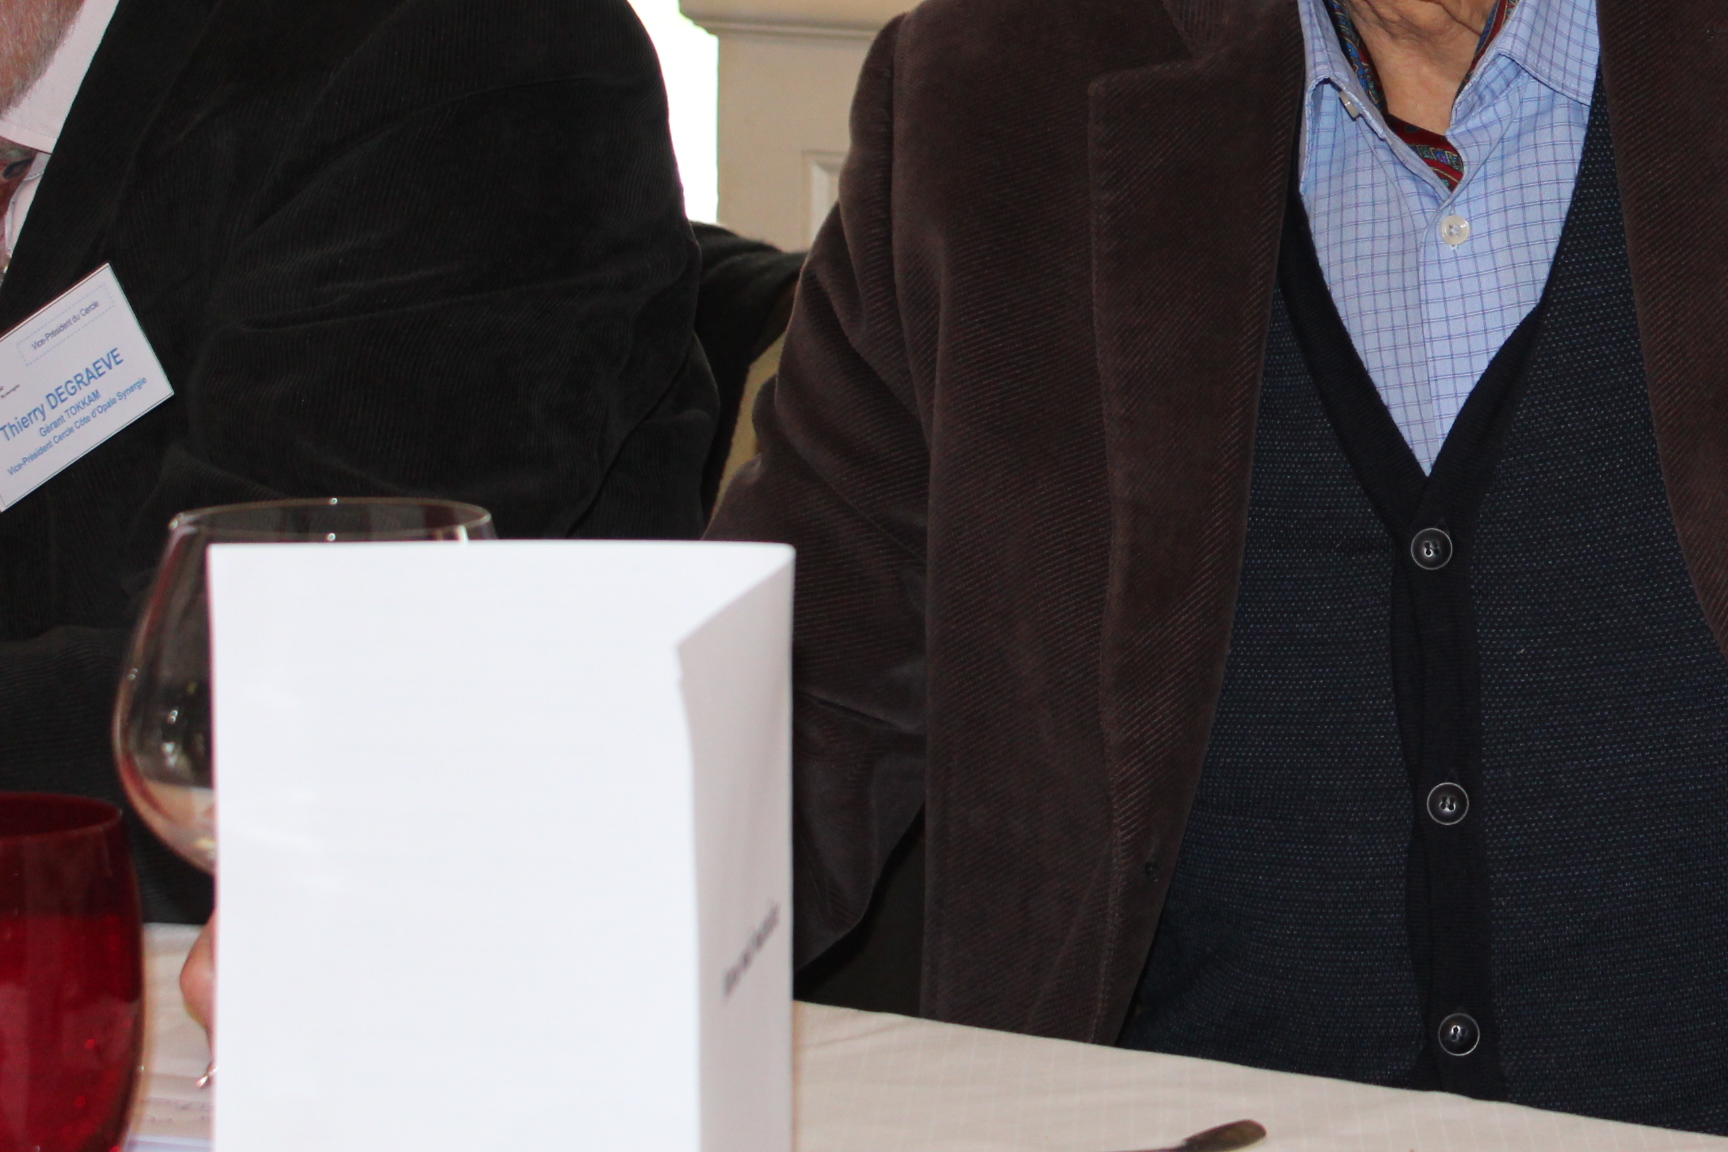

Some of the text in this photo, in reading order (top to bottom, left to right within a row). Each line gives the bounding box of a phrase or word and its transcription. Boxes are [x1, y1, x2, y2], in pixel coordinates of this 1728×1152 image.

[31, 300, 100, 350] Vice-Président du Cercle
[0, 347, 124, 441] Thierry DEGRAEVE
[7, 377, 147, 475] Vice-Président Cercle Côte d'Opale Synergie
[39, 389, 101, 437] Gérant TOKKAM
